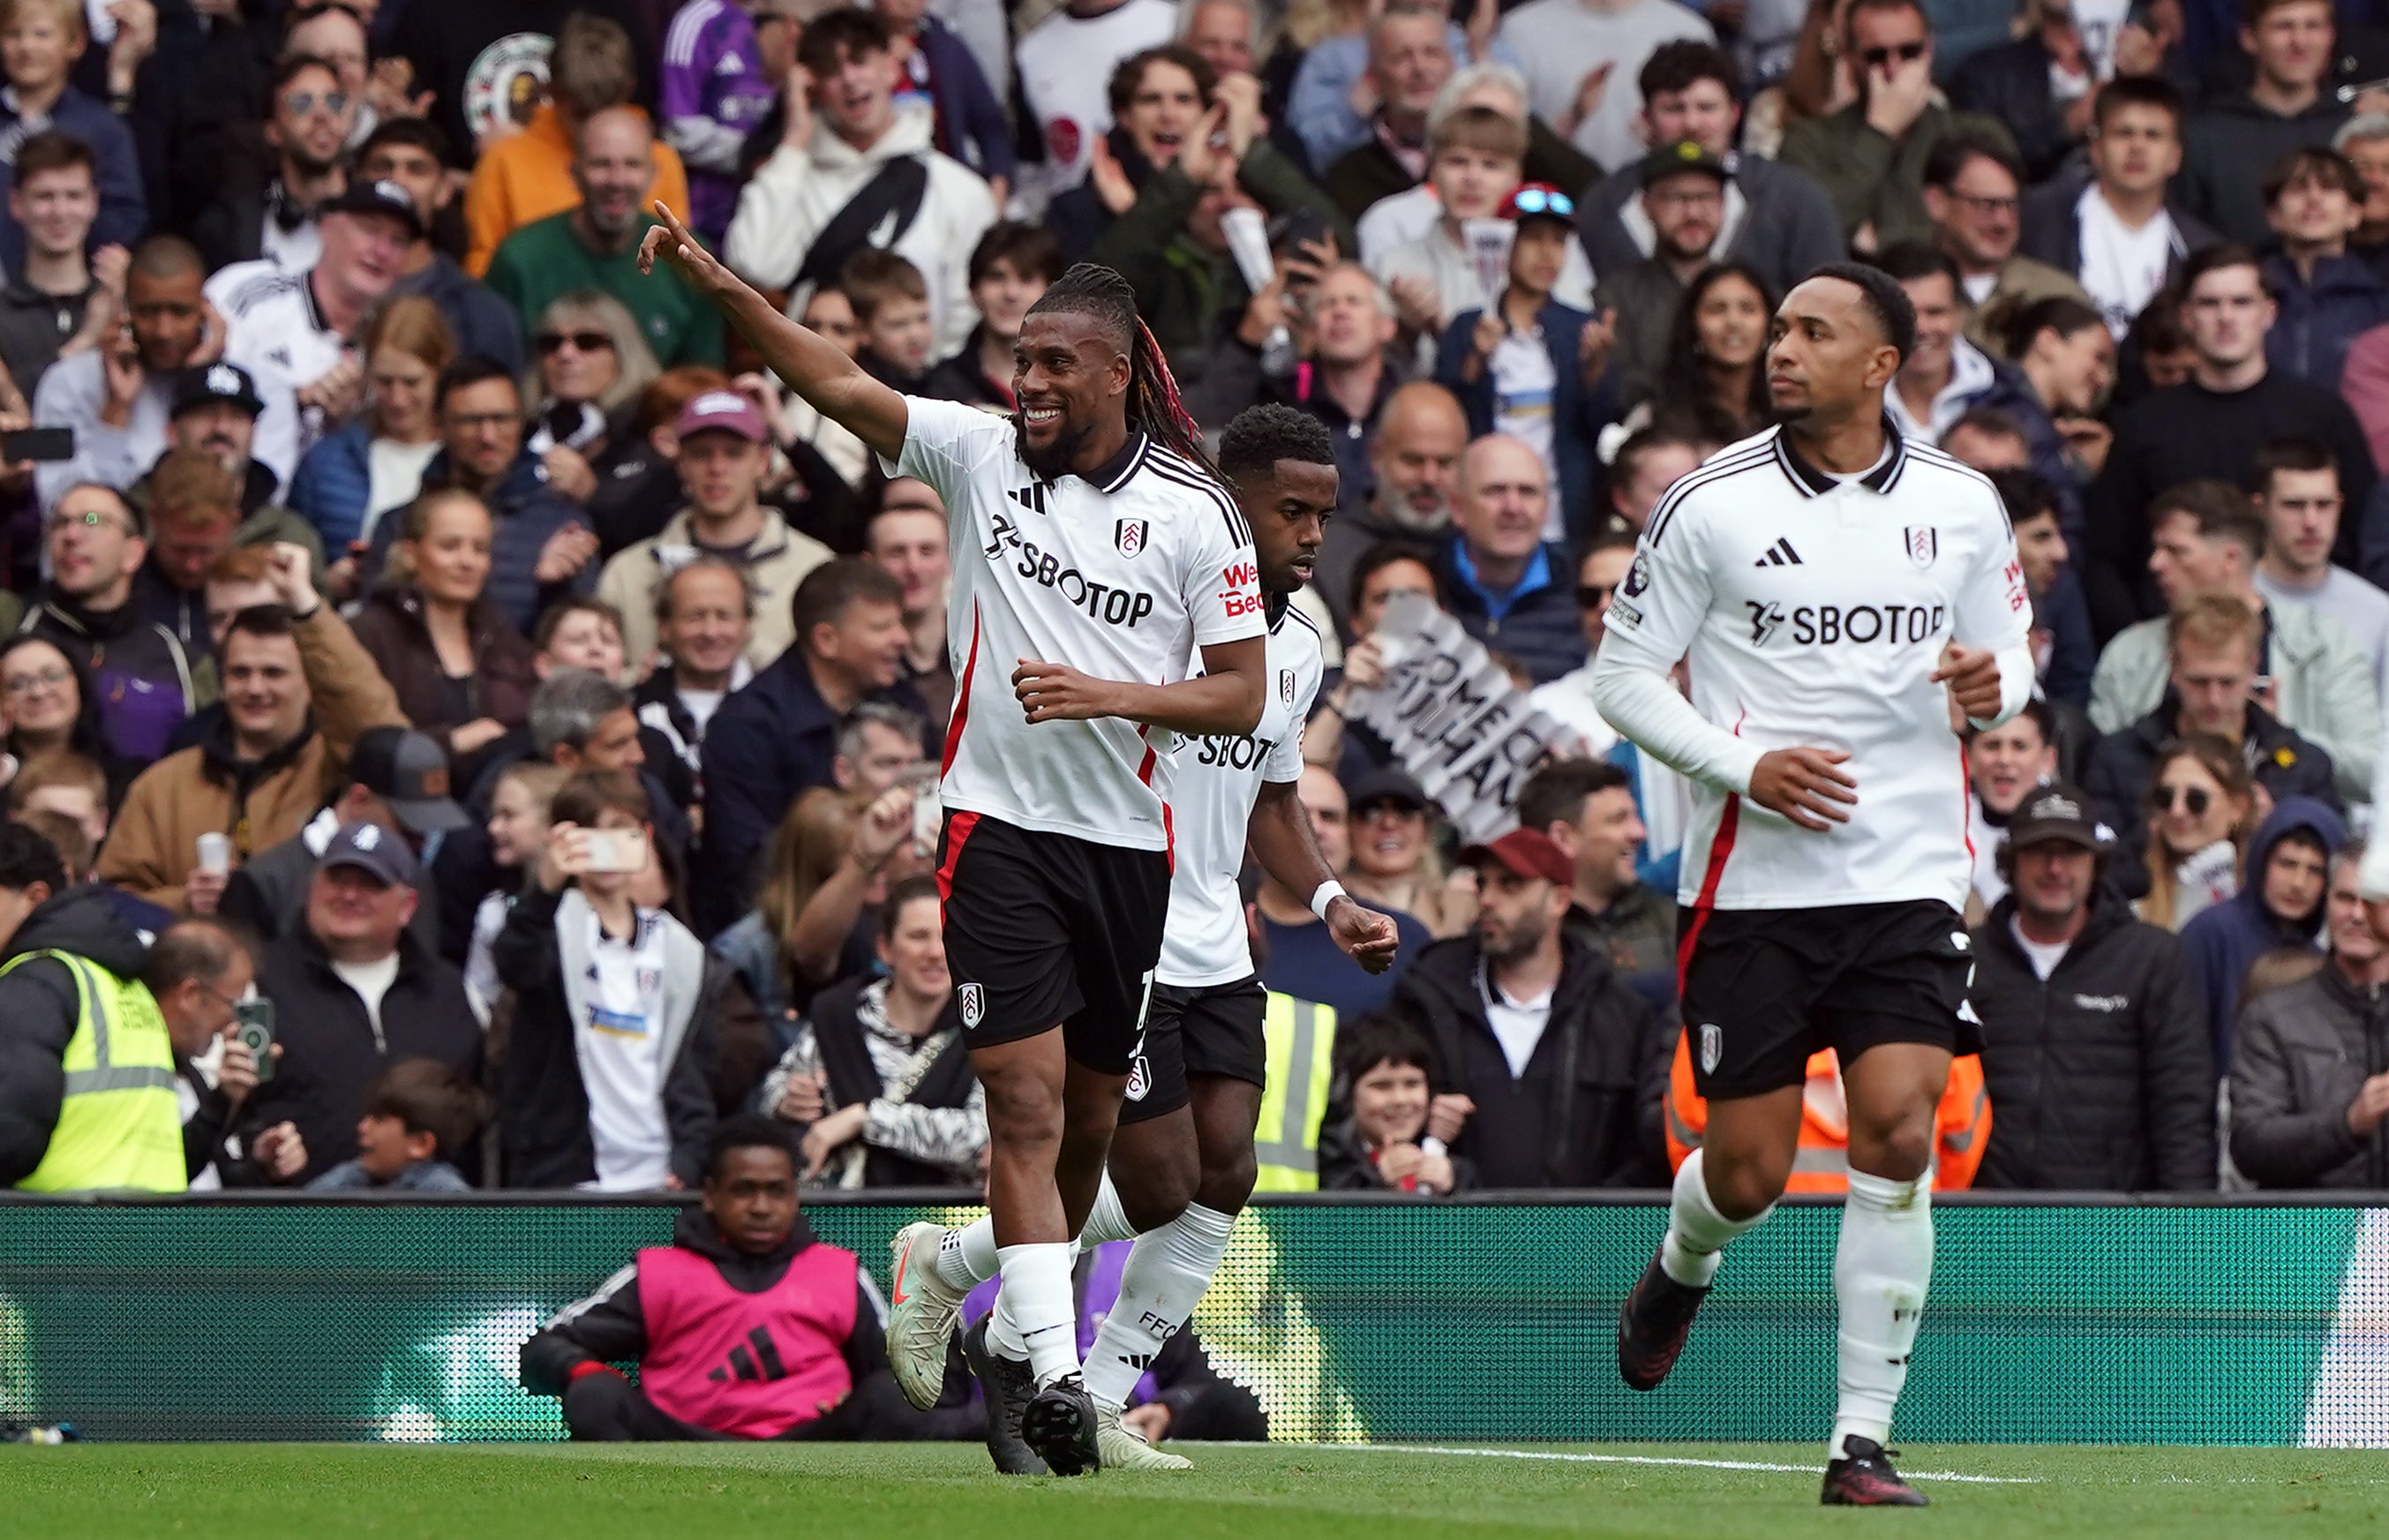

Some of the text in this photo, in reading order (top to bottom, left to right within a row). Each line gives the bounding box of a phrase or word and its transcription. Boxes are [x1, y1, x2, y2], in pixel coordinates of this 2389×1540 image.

[1123, 522, 1140, 552] FFC
[1017, 541, 1153, 628] SBOTOP
[1792, 605, 1944, 645] SBOTOP
[1198, 734, 1279, 771] SBOT
[964, 989, 976, 1020] FFC
[1138, 1311, 1177, 1340] FFC
